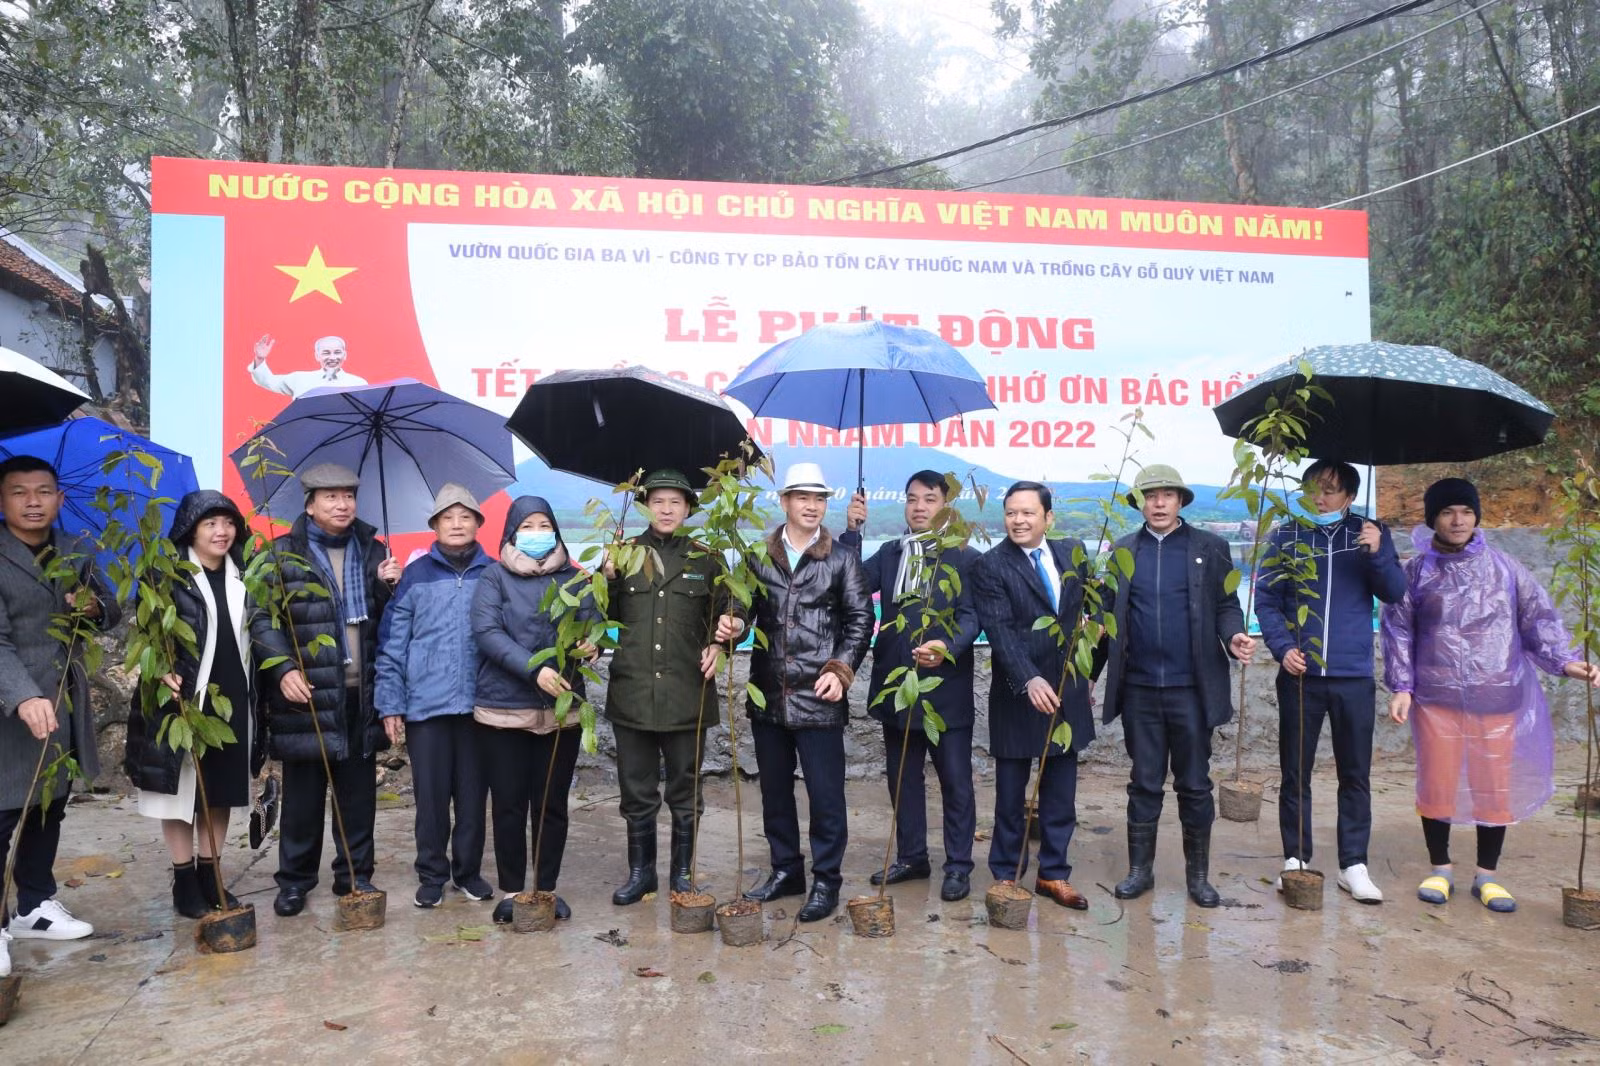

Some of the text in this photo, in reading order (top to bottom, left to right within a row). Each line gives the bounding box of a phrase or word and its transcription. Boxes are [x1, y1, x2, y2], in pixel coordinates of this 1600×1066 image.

[208, 173, 1324, 241] NƯỚC CỘNG HÒA XÃ HỘI CHỦ NGHĨA VIỆT NAM MUÔN NĂM!
[448, 241, 502, 259] VƯỜN
[507, 242, 559, 260] QUỐC
[564, 247, 596, 261] GIA
[601, 249, 627, 262] BA
[632, 247, 651, 263] VÌ
[669, 248, 720, 265] CÔNG
[725, 252, 749, 266] TY
[753, 253, 778, 267] CP
[782, 250, 819, 268] BẢO
[864, 254, 900, 270] CÂY
[905, 255, 963, 273] THUỐC
[968, 260, 1008, 274] NAM
[1012, 259, 1036, 275] VÀ
[1040, 260, 1096, 277] TRỒNG
[1100, 262, 1132, 278] CÂY
[1137, 262, 1159, 280] GỖ
[1199, 267, 1235, 284] VIỆT
[1238, 270, 1275, 285] NAM
[665, 296, 738, 342] LỄ
[937, 308, 1096, 355] ĐỘNG
[1059, 374, 1108, 405] ƠN
[1121, 371, 1189, 406] BÁC
[1009, 420, 1096, 448] 2022
